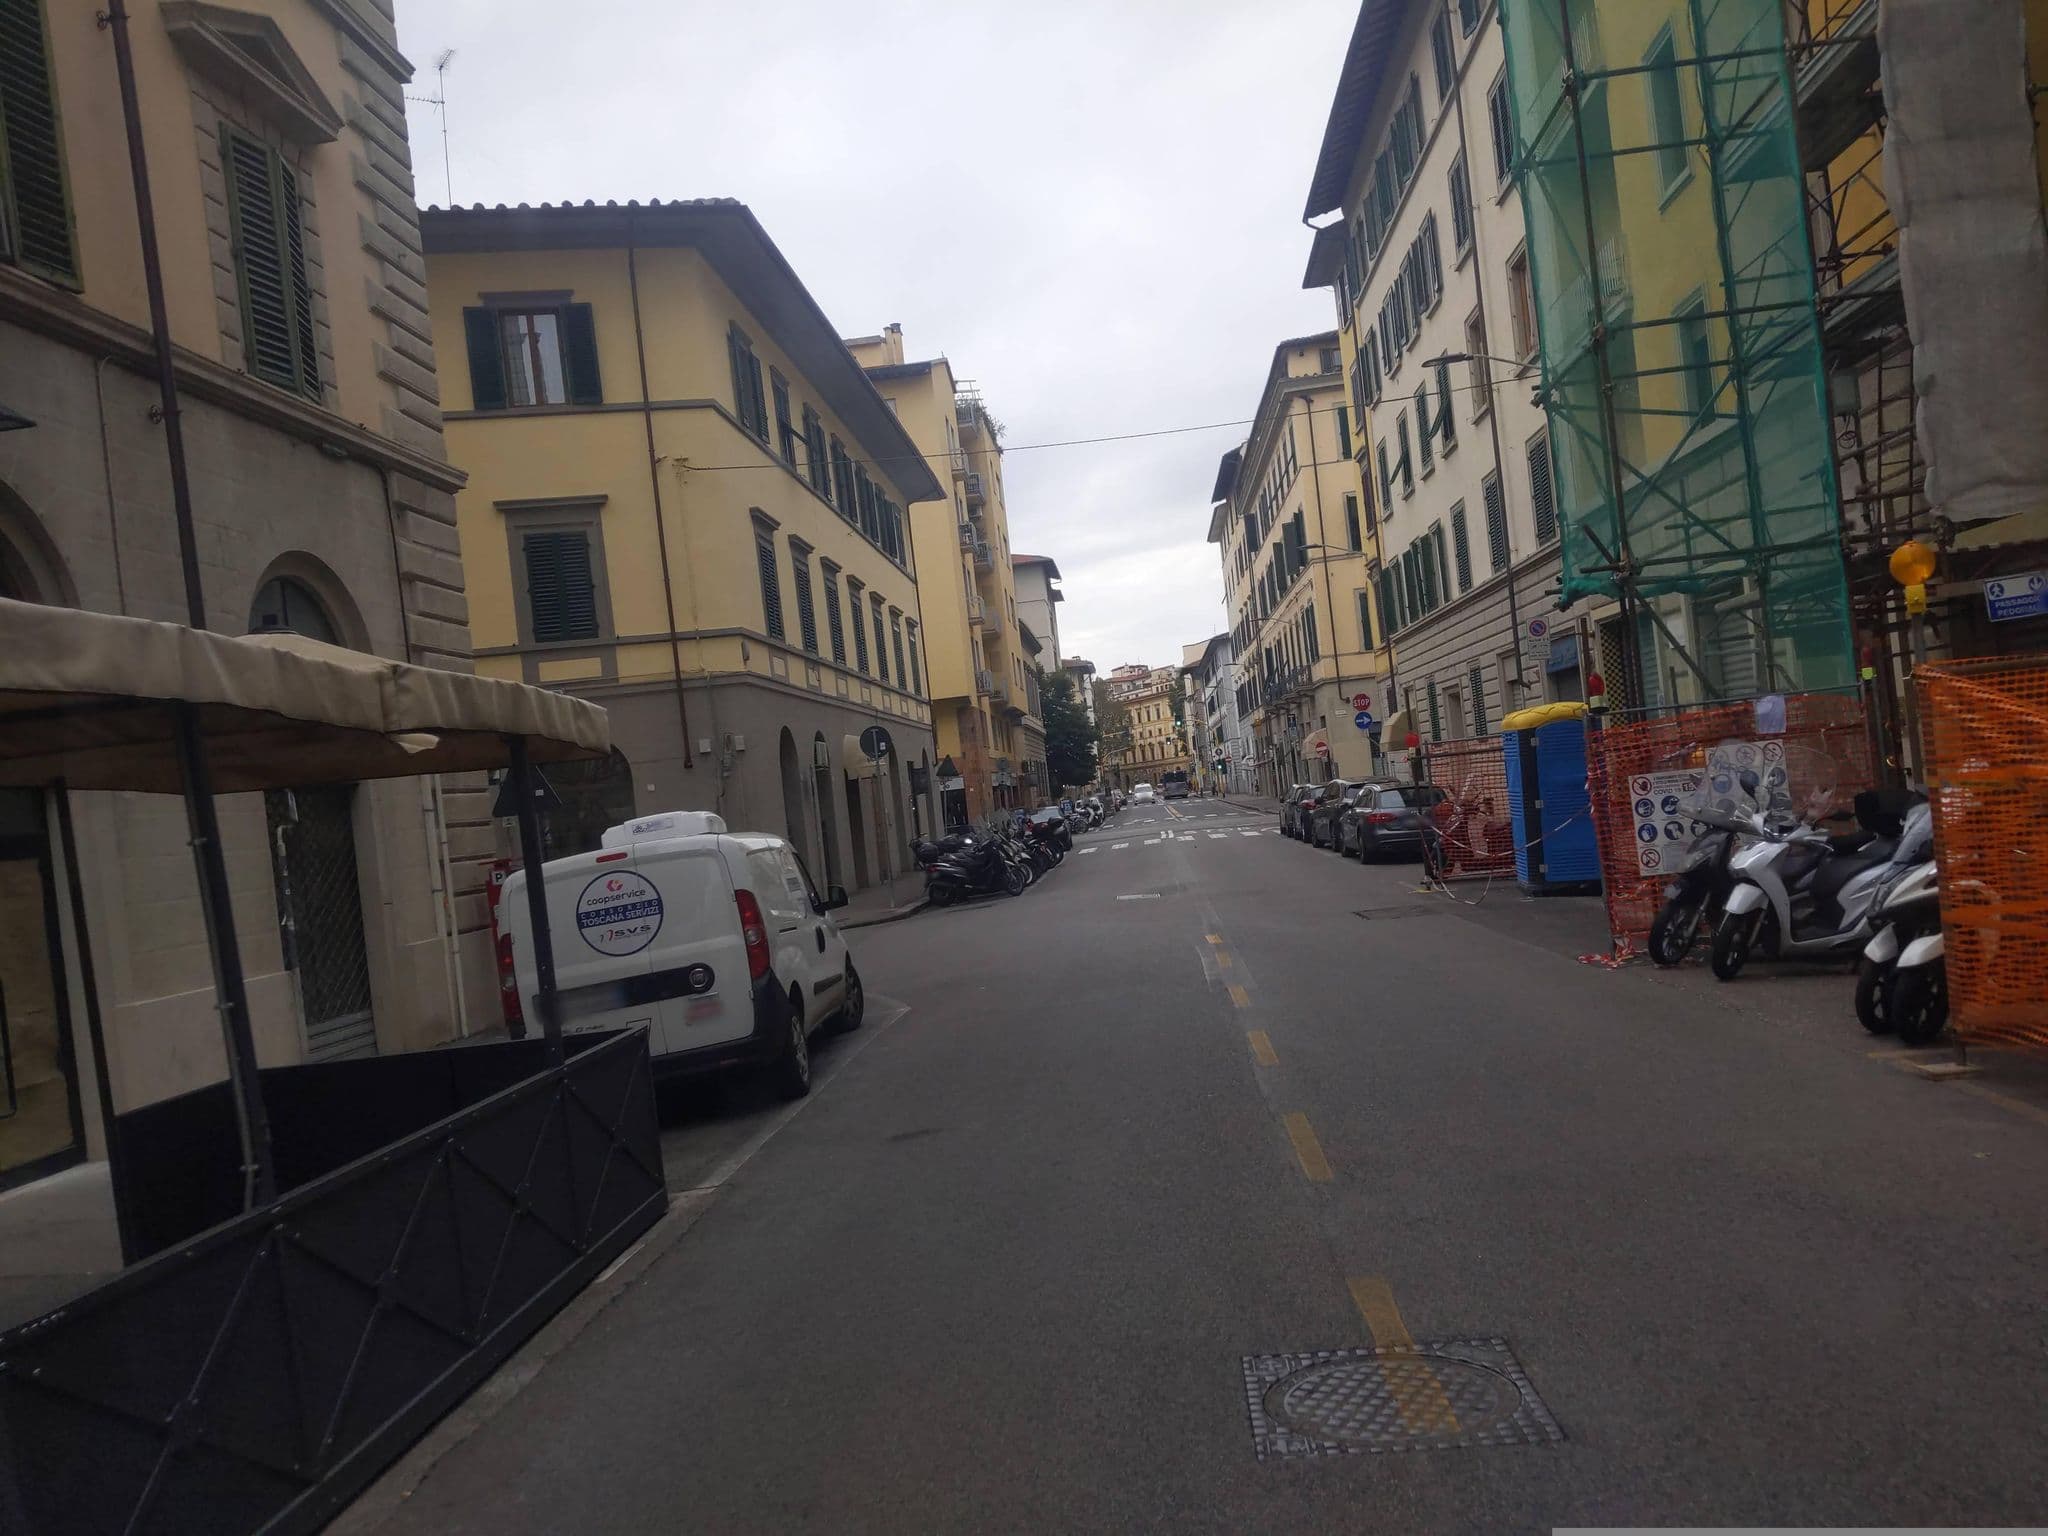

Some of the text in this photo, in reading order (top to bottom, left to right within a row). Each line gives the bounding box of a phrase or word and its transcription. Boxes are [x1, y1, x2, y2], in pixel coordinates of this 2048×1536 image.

[1994, 595, 2041, 608] PASSAGG
[1354, 698, 1370, 707] STOP
[586, 889, 647, 906] coopservice
[580, 900, 659, 920] CONSORZIO
[582, 906, 660, 927] TOSCANA SERVIZI
